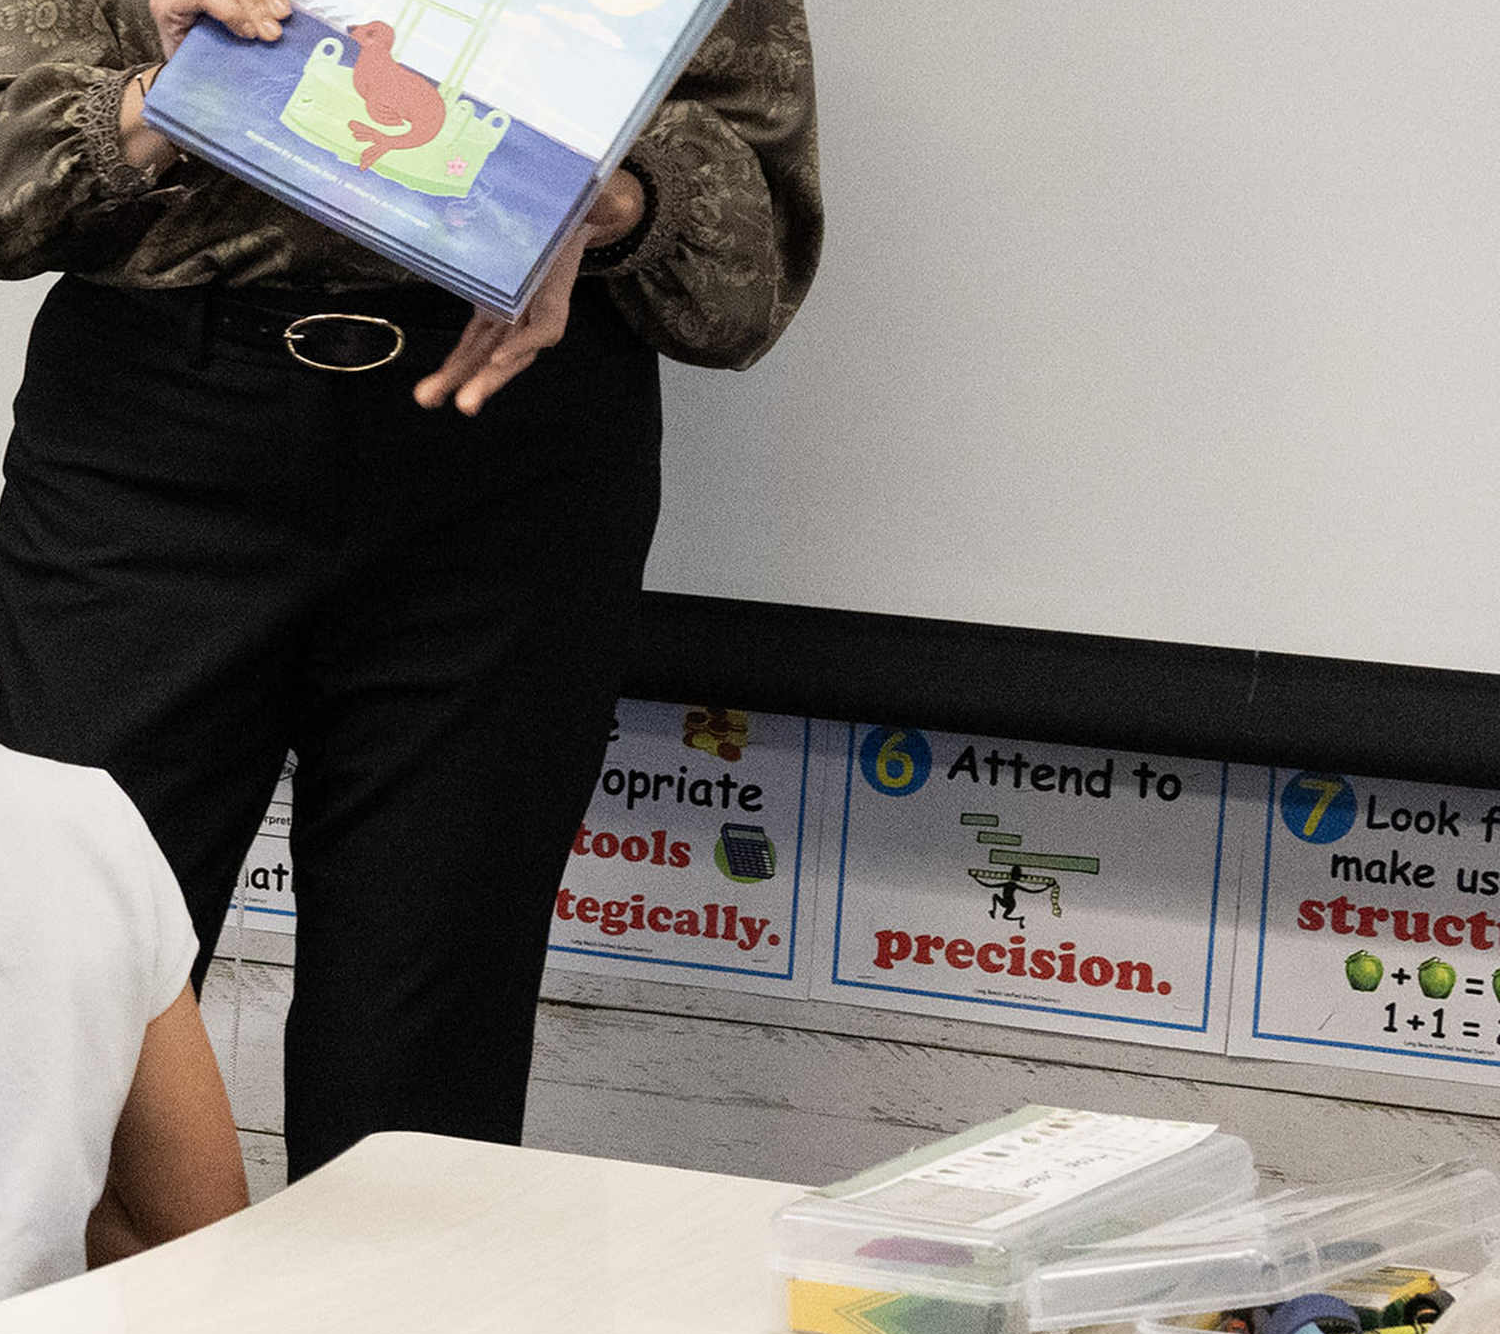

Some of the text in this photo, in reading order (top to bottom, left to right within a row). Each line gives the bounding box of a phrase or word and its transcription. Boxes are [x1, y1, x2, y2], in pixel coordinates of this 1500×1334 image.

[602, 765, 764, 813] opriate
[876, 728, 1182, 802] 6 Attend to
[1292, 780, 1342, 837] 7
[1365, 794, 1461, 839] Look
[573, 821, 692, 870] tools
[1330, 849, 1436, 889] make
[553, 887, 781, 951] tegically.
[1297, 895, 1500, 951] struct
[872, 927, 1173, 996] precision.
